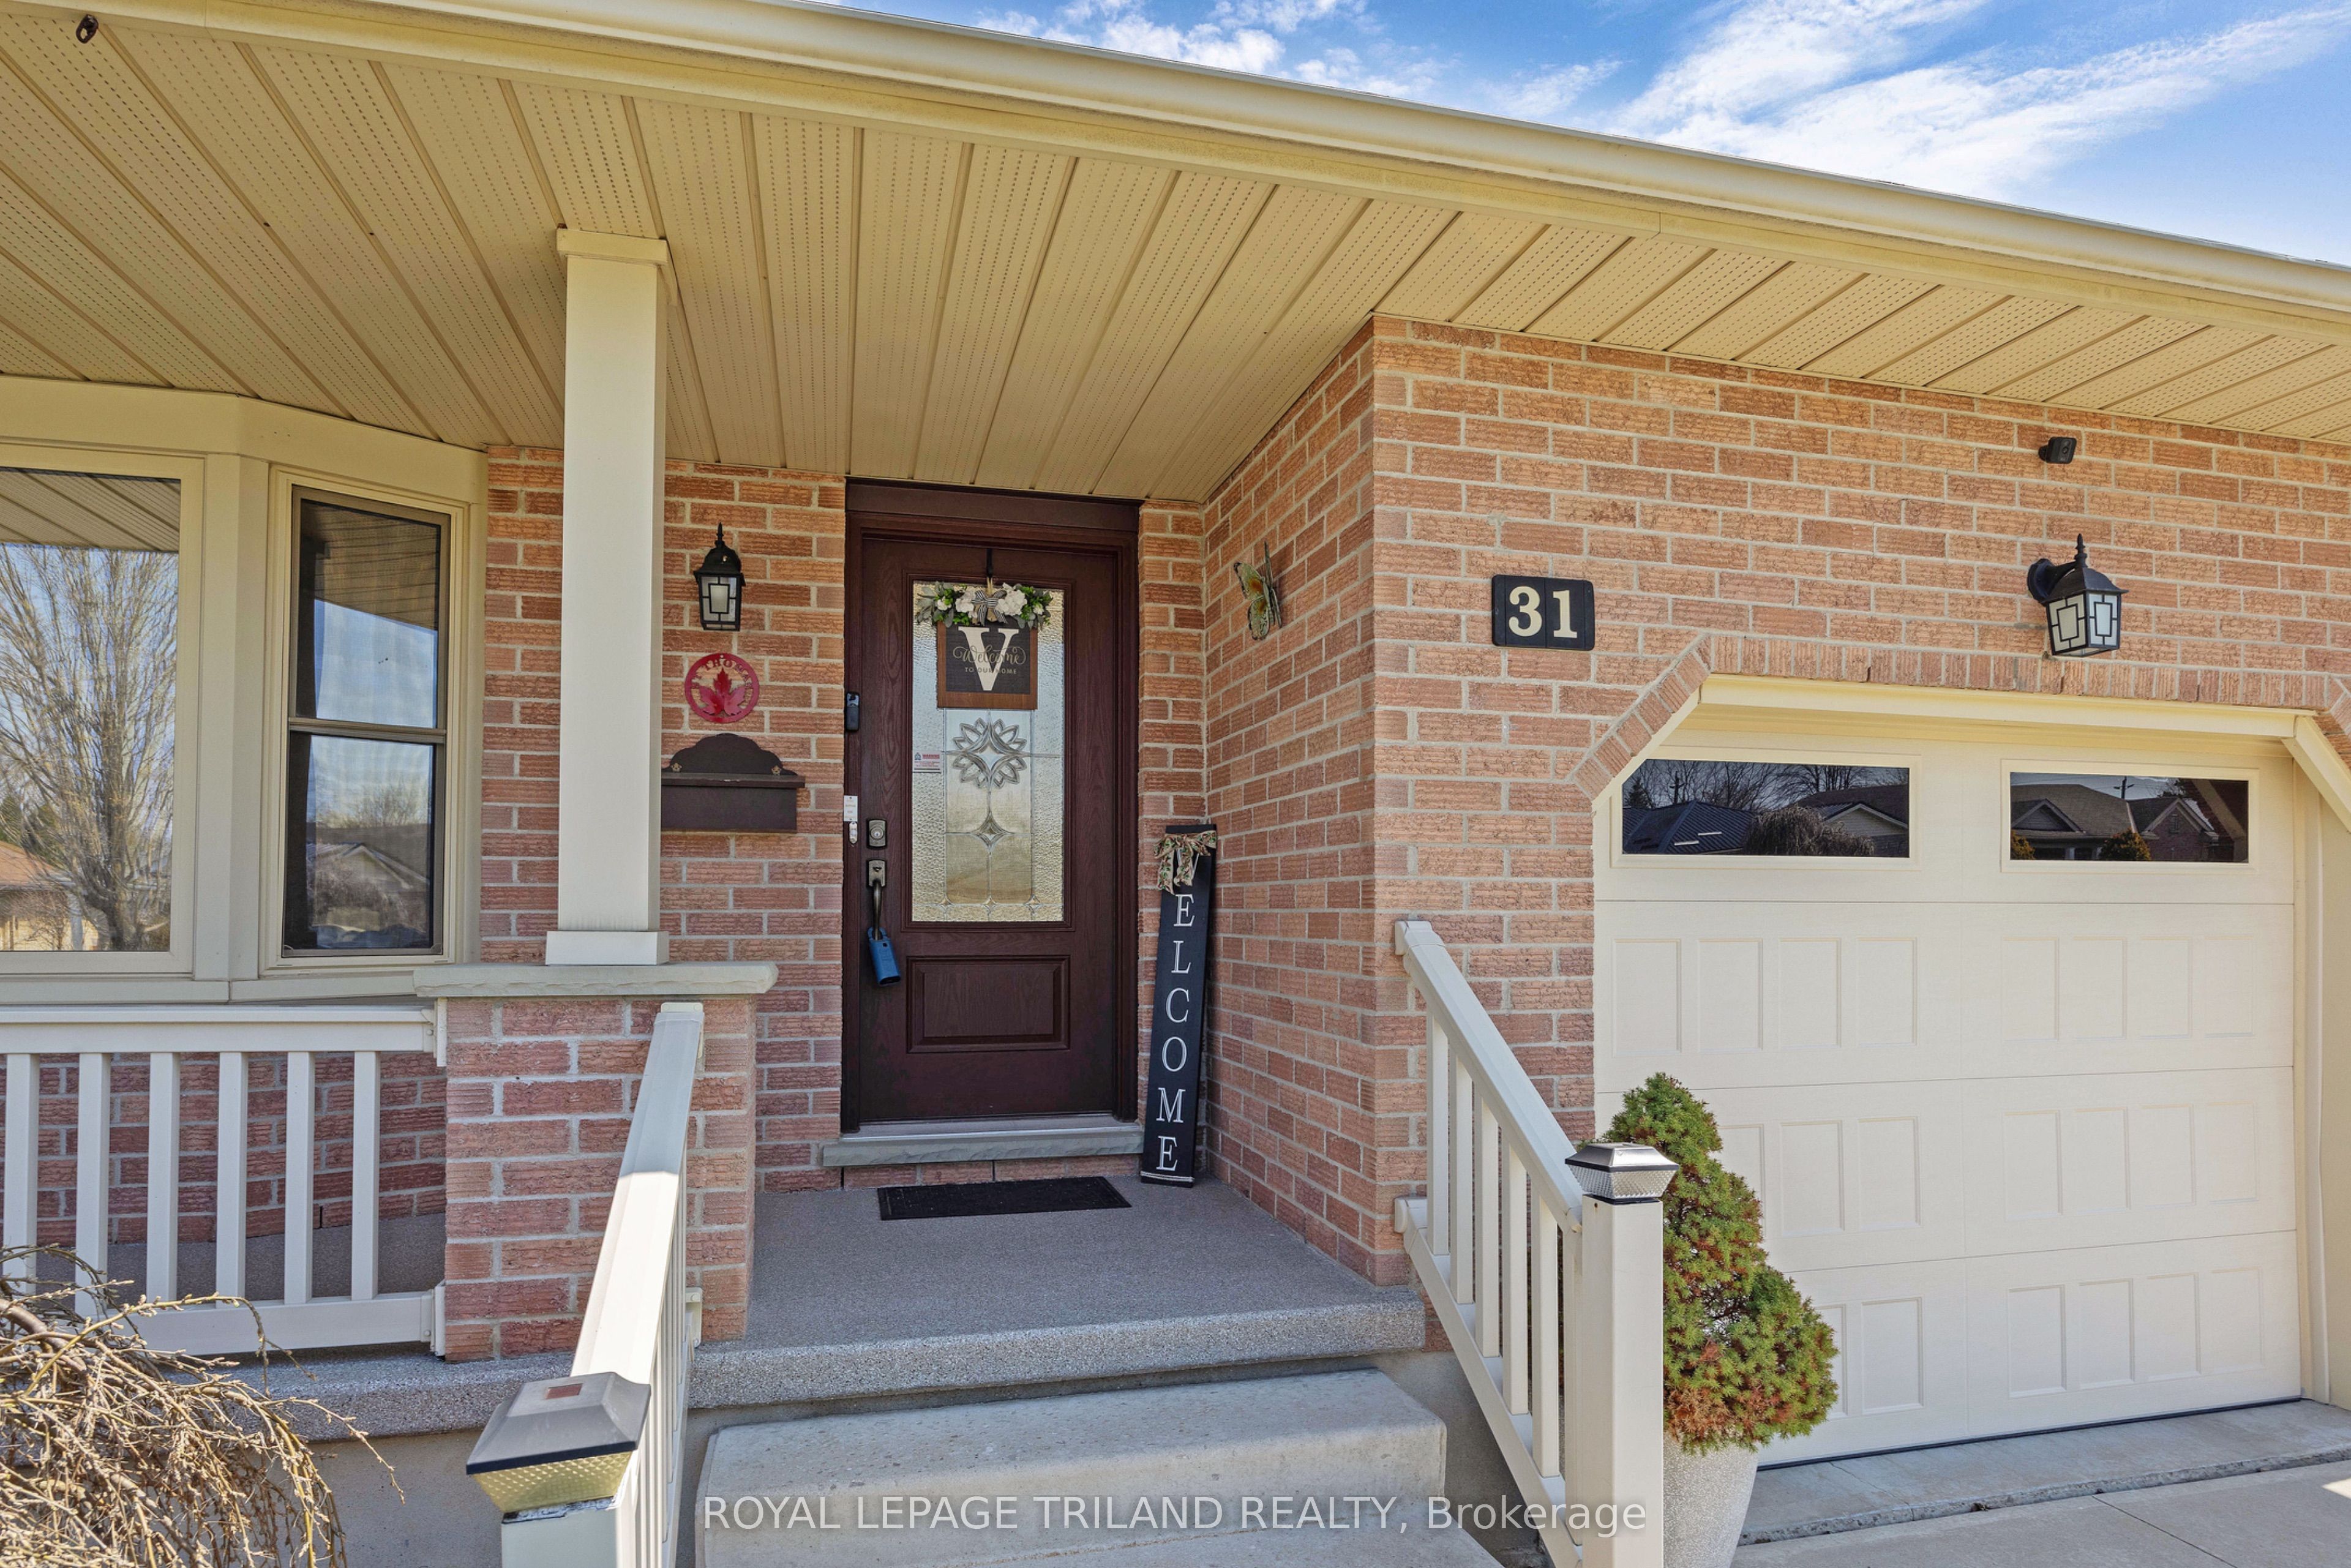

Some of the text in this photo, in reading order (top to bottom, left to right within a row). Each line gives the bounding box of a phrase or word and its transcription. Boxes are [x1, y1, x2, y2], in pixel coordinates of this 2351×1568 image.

[1509, 585, 1578, 639] 31
[952, 644, 1027, 666] Welcome
[958, 626, 1019, 691] V
